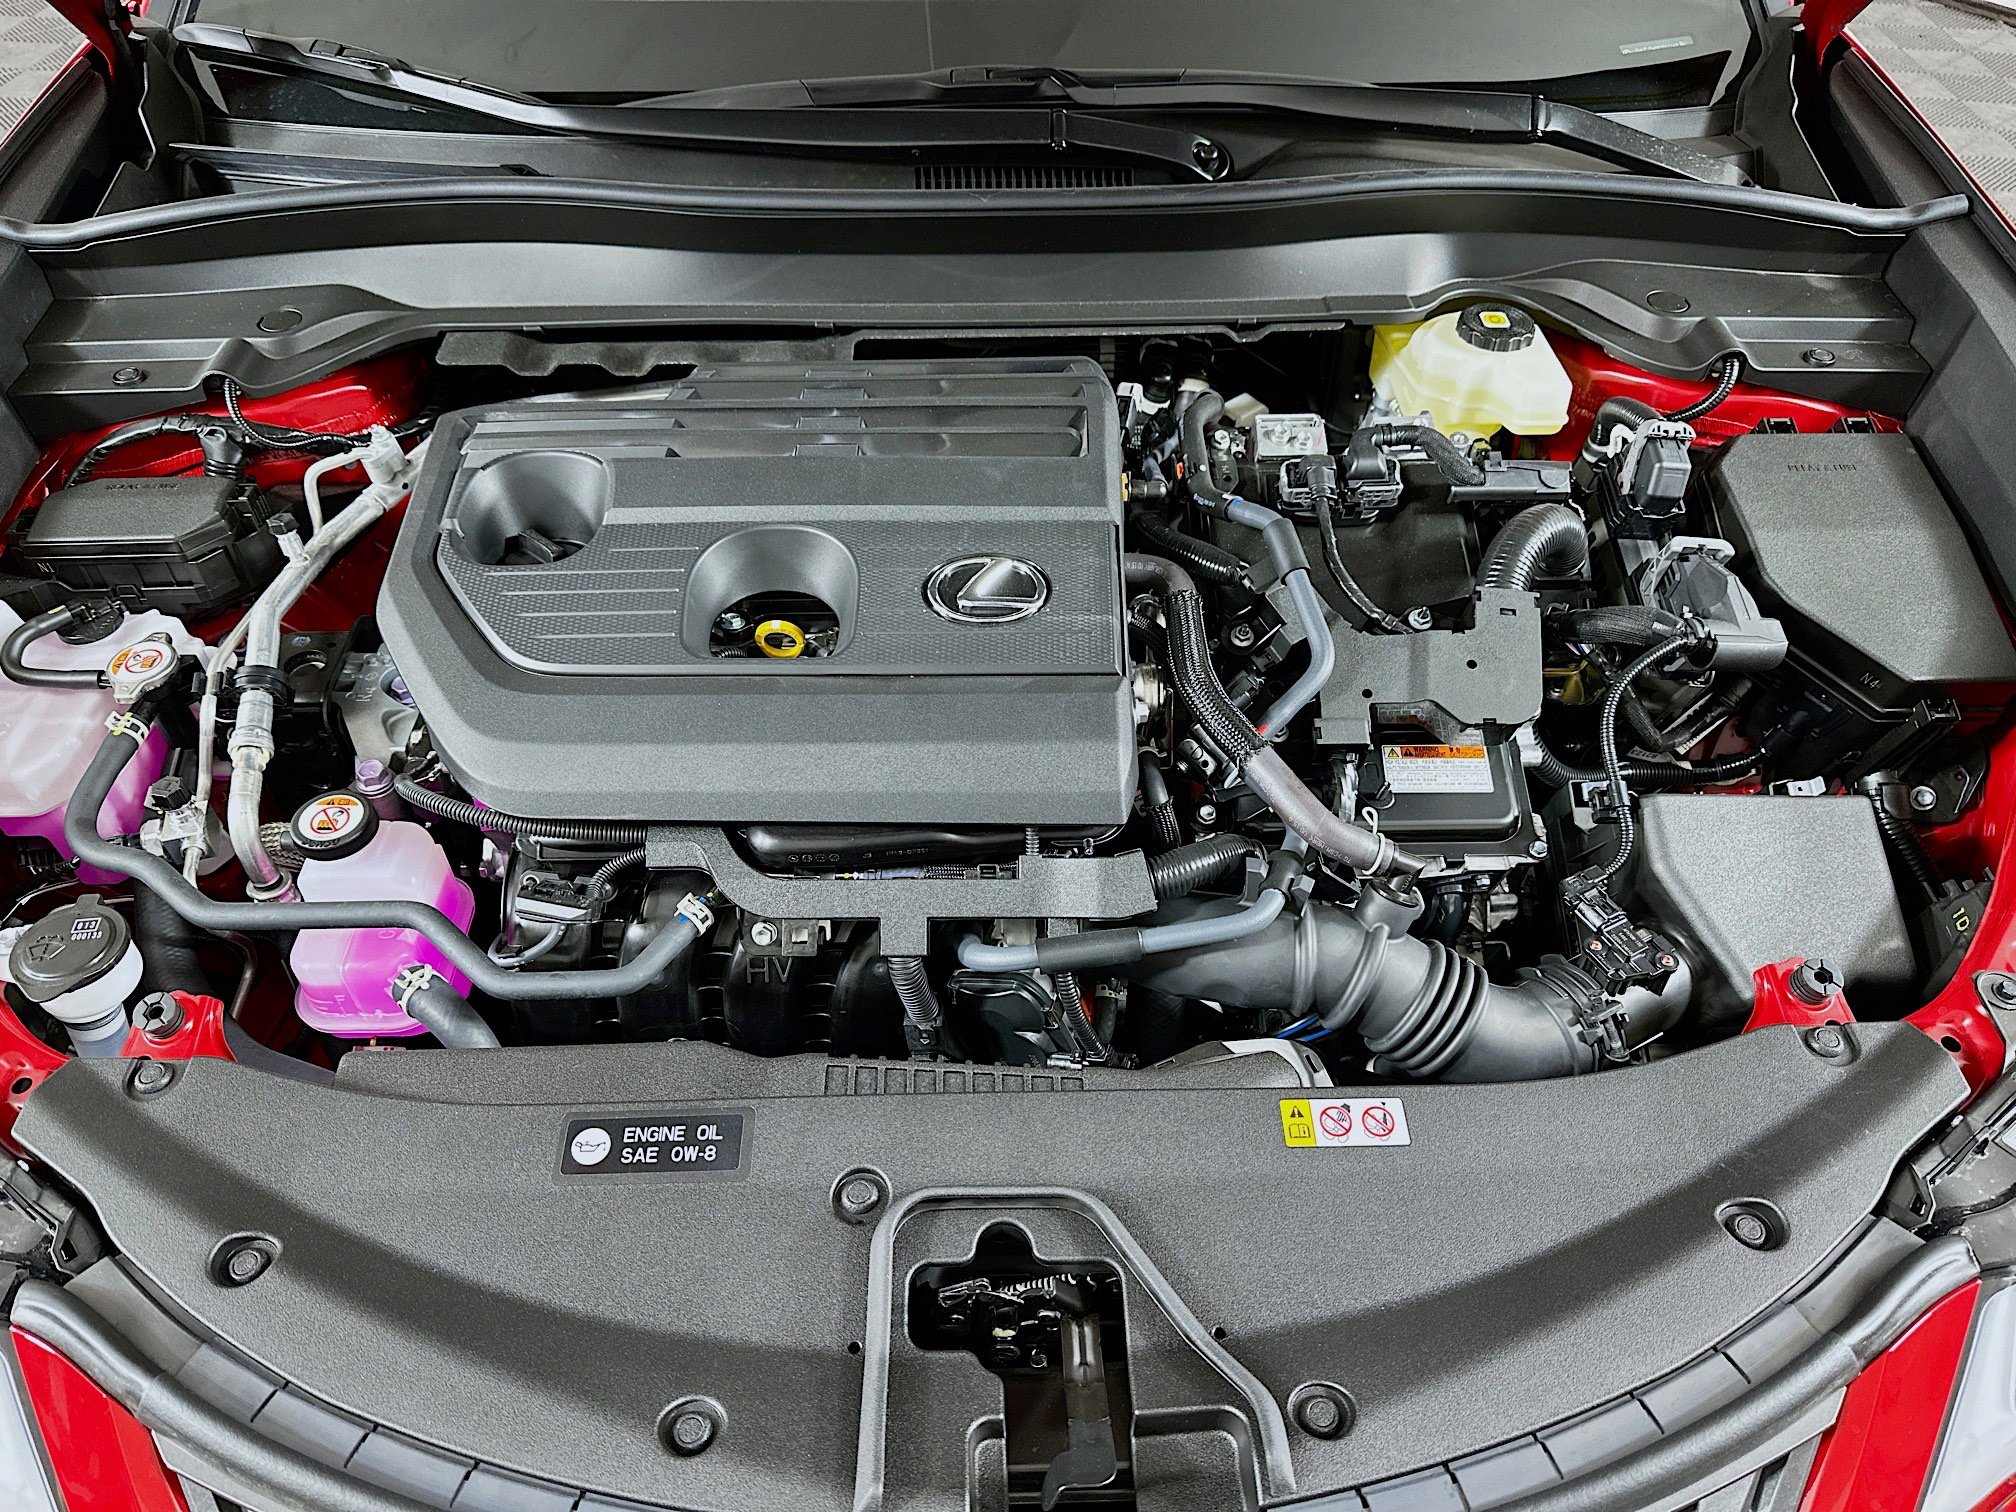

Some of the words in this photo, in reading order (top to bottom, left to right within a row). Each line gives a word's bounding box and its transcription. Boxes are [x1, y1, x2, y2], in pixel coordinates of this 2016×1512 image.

[746, 956, 793, 984] HV
[623, 1125, 686, 1143] ENGINE
[696, 1124, 724, 1141] OIL
[620, 1147, 659, 1164] SAE
[671, 1145, 717, 1162] 0W-8
